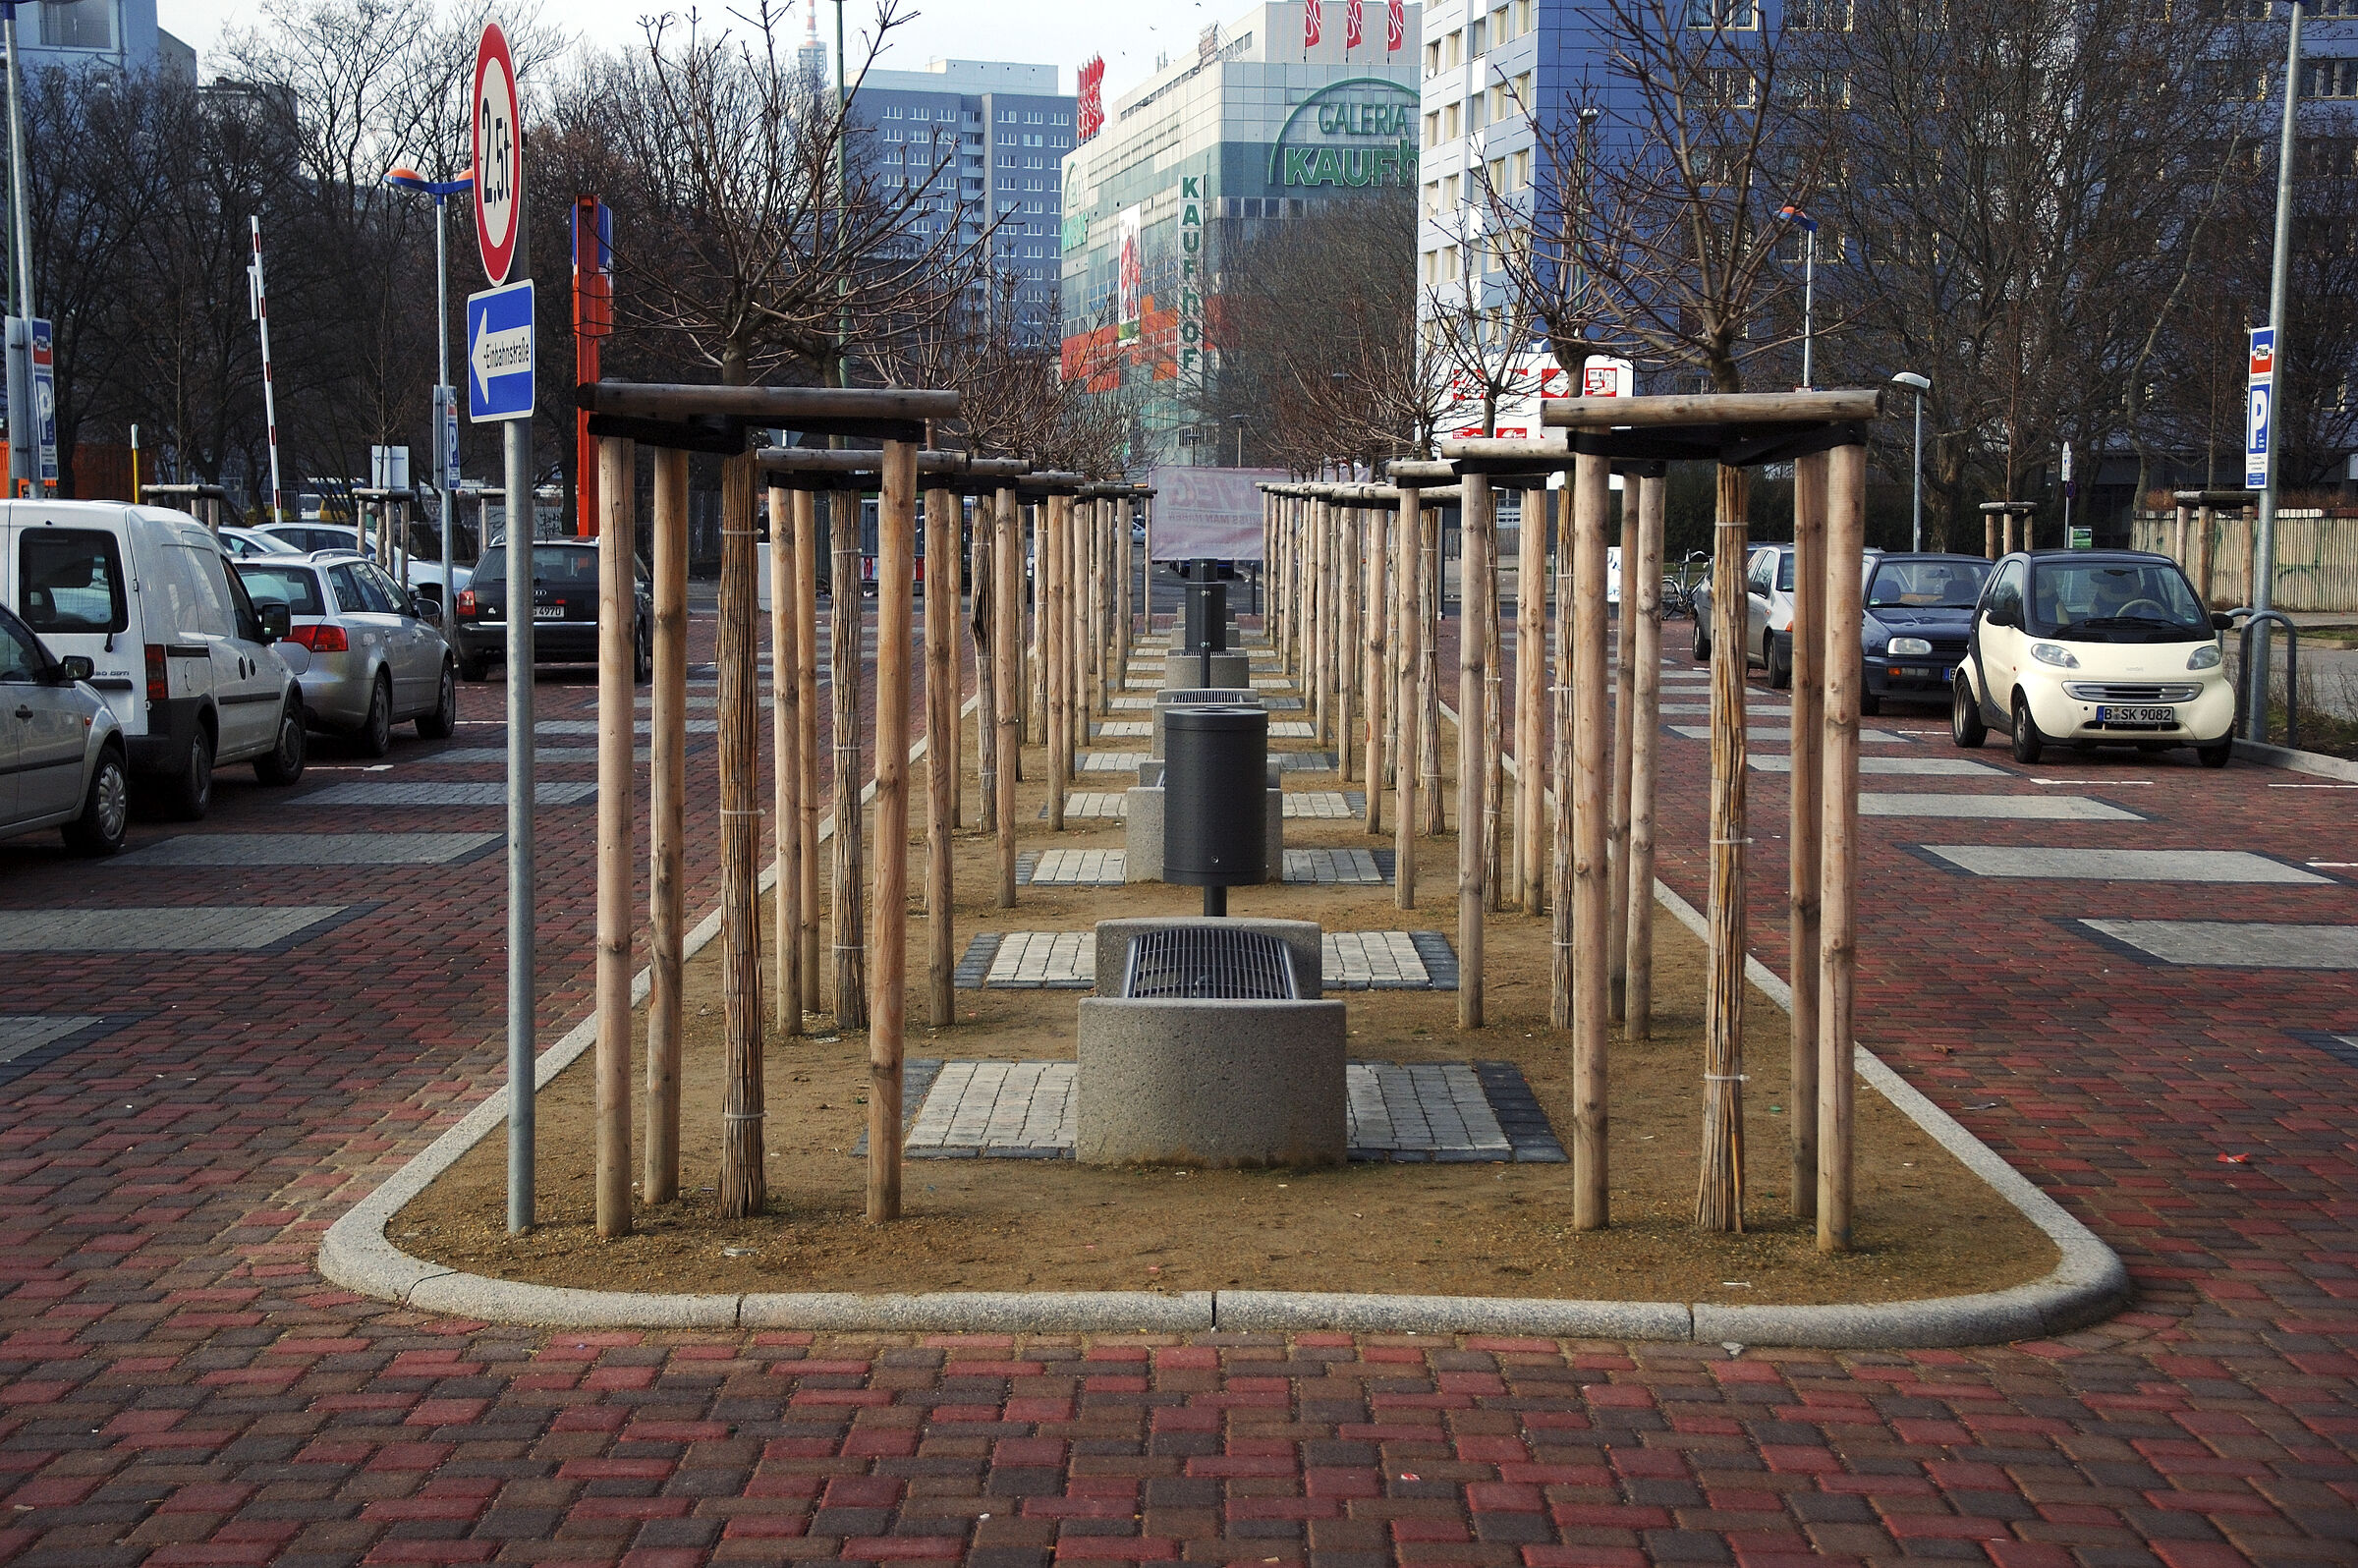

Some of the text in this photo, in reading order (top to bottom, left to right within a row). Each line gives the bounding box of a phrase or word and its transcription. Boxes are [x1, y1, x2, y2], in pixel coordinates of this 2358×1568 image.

[1317, 102, 1408, 136] GALERIA
[481, 97, 511, 209] 2,5t
[485, 336, 530, 369] Einbahnstraße
[2249, 389, 2268, 449] P
[538, 605, 561, 616] 4970
[2104, 708, 2171, 720] B SK 9082
